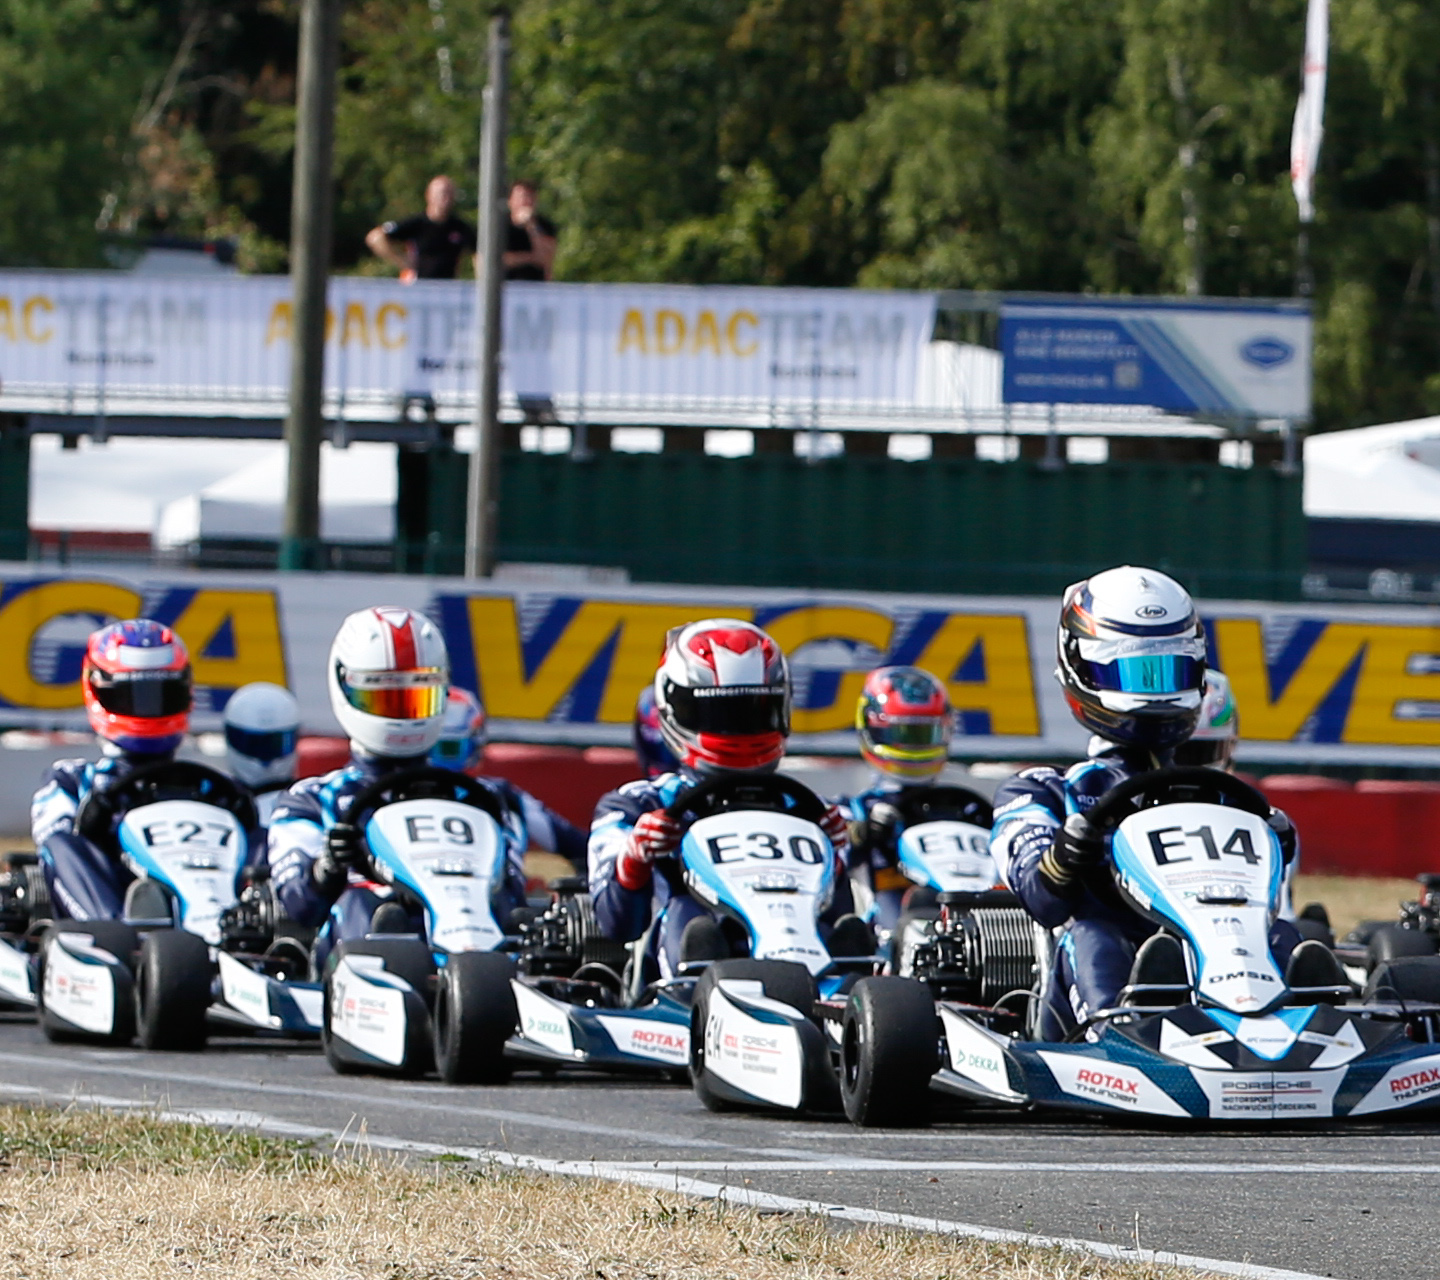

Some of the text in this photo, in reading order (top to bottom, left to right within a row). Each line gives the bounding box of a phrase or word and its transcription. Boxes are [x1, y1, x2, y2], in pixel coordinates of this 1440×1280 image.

[265, 300, 408, 350] AAC
[618, 307, 760, 357] ADAC
[142, 821, 233, 847] E27
[404, 815, 475, 845] E9
[706, 832, 824, 865] E30
[1146, 825, 1263, 866] E14
[1209, 971, 1275, 984] DMSB
[632, 1029, 686, 1049] ROTAX
[968, 1056, 1000, 1074] DEKRA
[1076, 1068, 1139, 1094] ROTAX
[1221, 1081, 1312, 1090] PORSCHE
